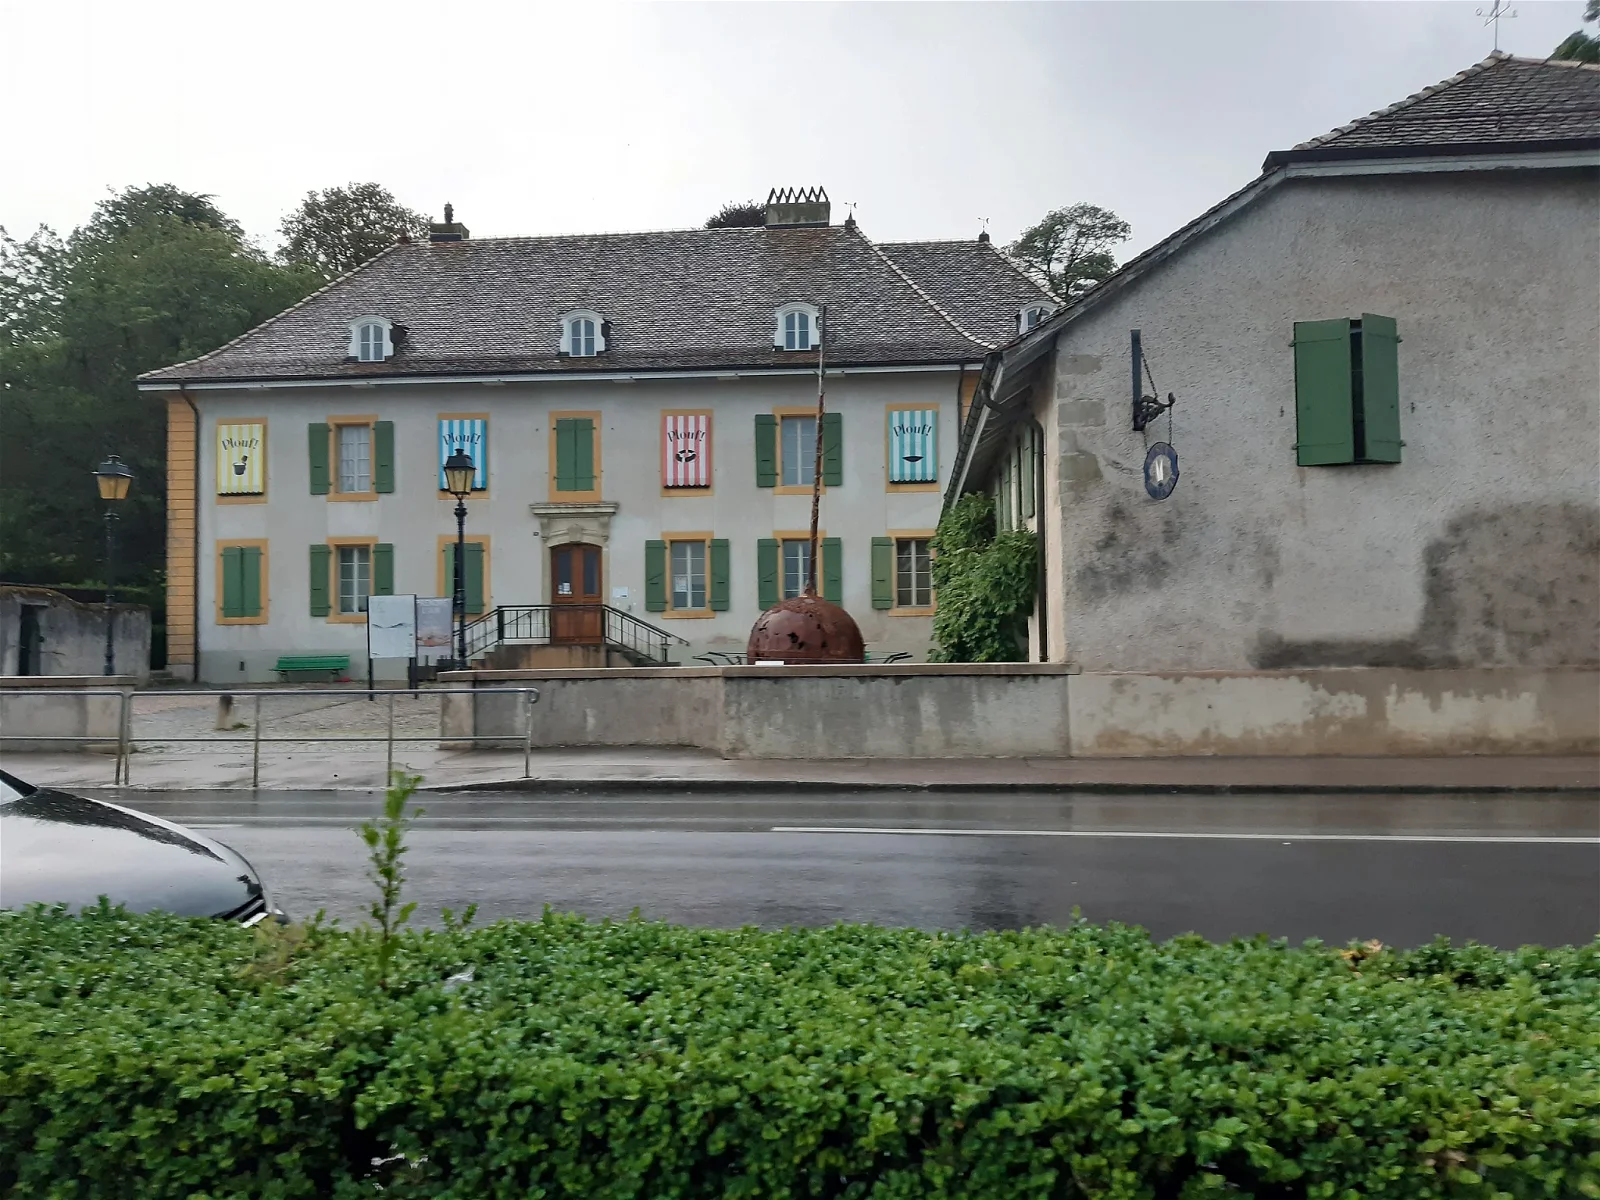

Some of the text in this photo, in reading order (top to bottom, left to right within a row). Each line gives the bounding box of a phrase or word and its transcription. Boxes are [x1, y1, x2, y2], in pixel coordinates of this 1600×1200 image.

[667, 429, 706, 443] Plouf!
[893, 423, 932, 437] Plouf!
[221, 437, 258, 451] Plouf!
[442, 432, 481, 445] Plouf!
